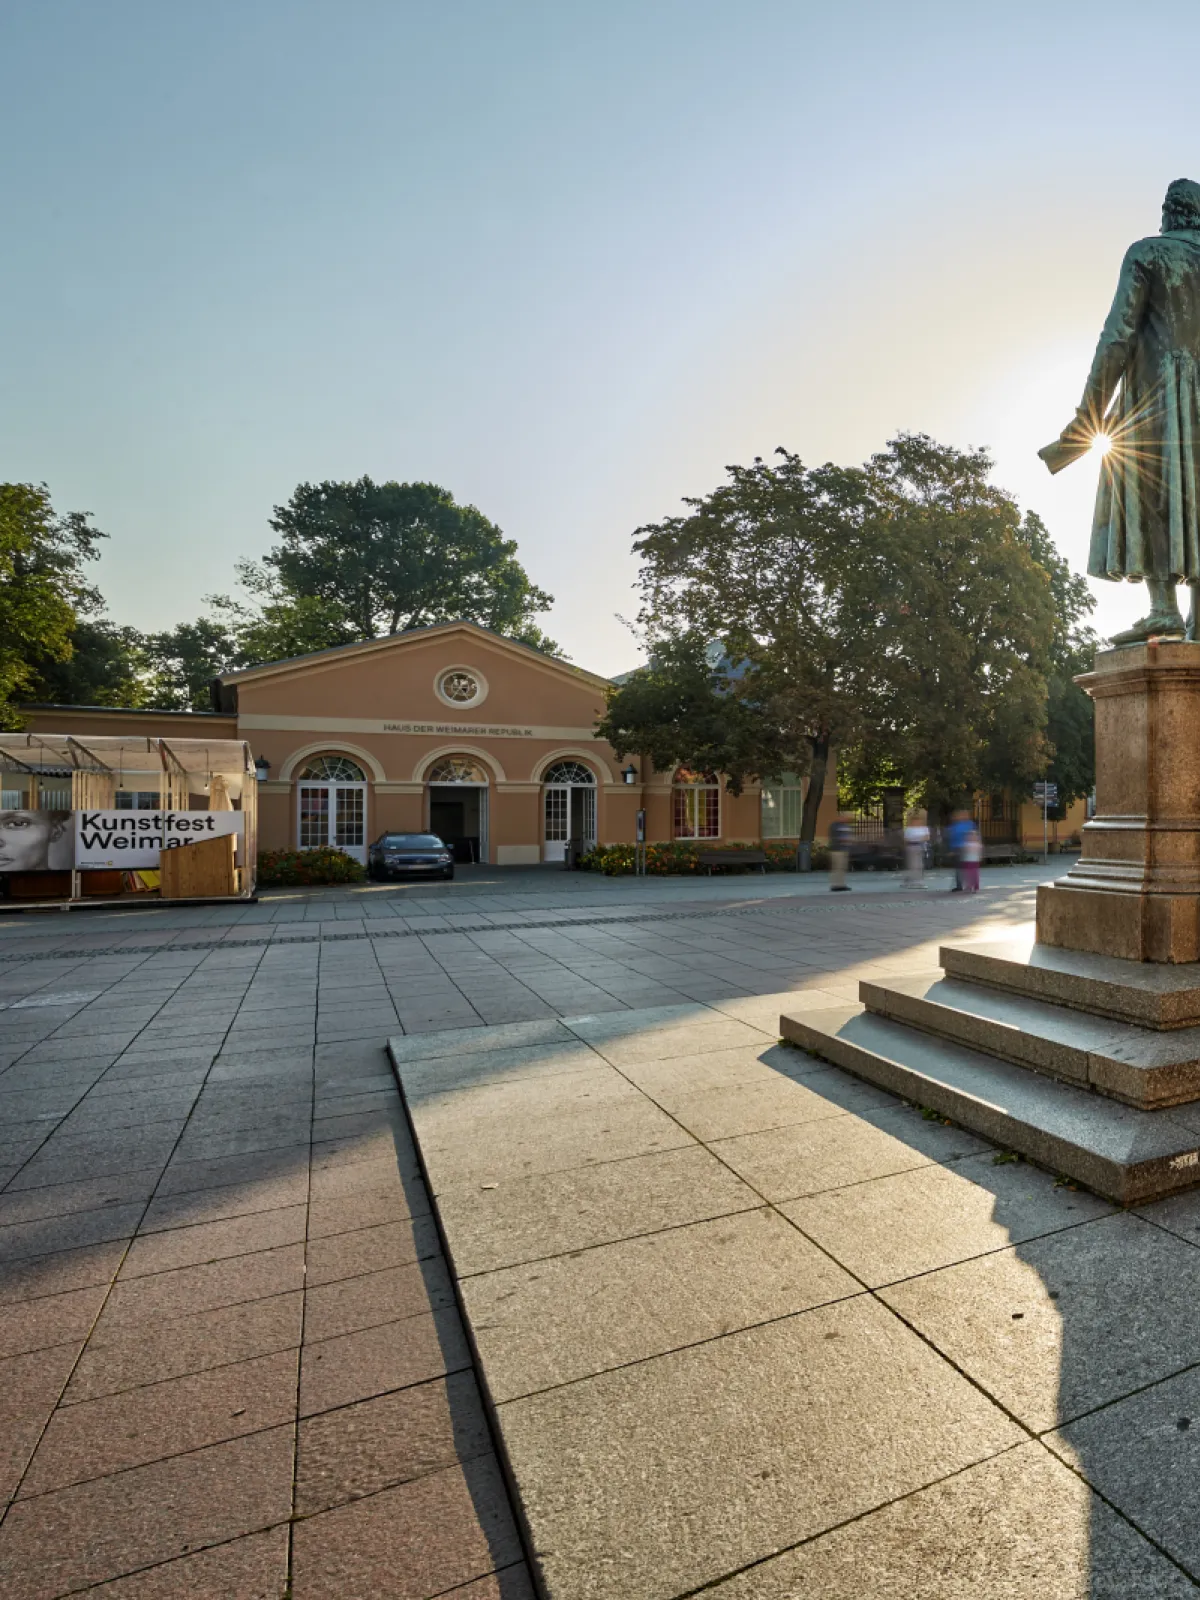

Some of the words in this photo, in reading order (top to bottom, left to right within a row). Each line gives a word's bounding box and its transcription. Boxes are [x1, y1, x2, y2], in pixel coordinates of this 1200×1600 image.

[383, 723, 412, 733] HAUS
[413, 725, 434, 733] DER
[436, 725, 487, 735] WEIMARER
[488, 728, 533, 737] REPUBLIK
[81, 813, 215, 831] Kunstfest
[80, 832, 194, 850] Weimar
